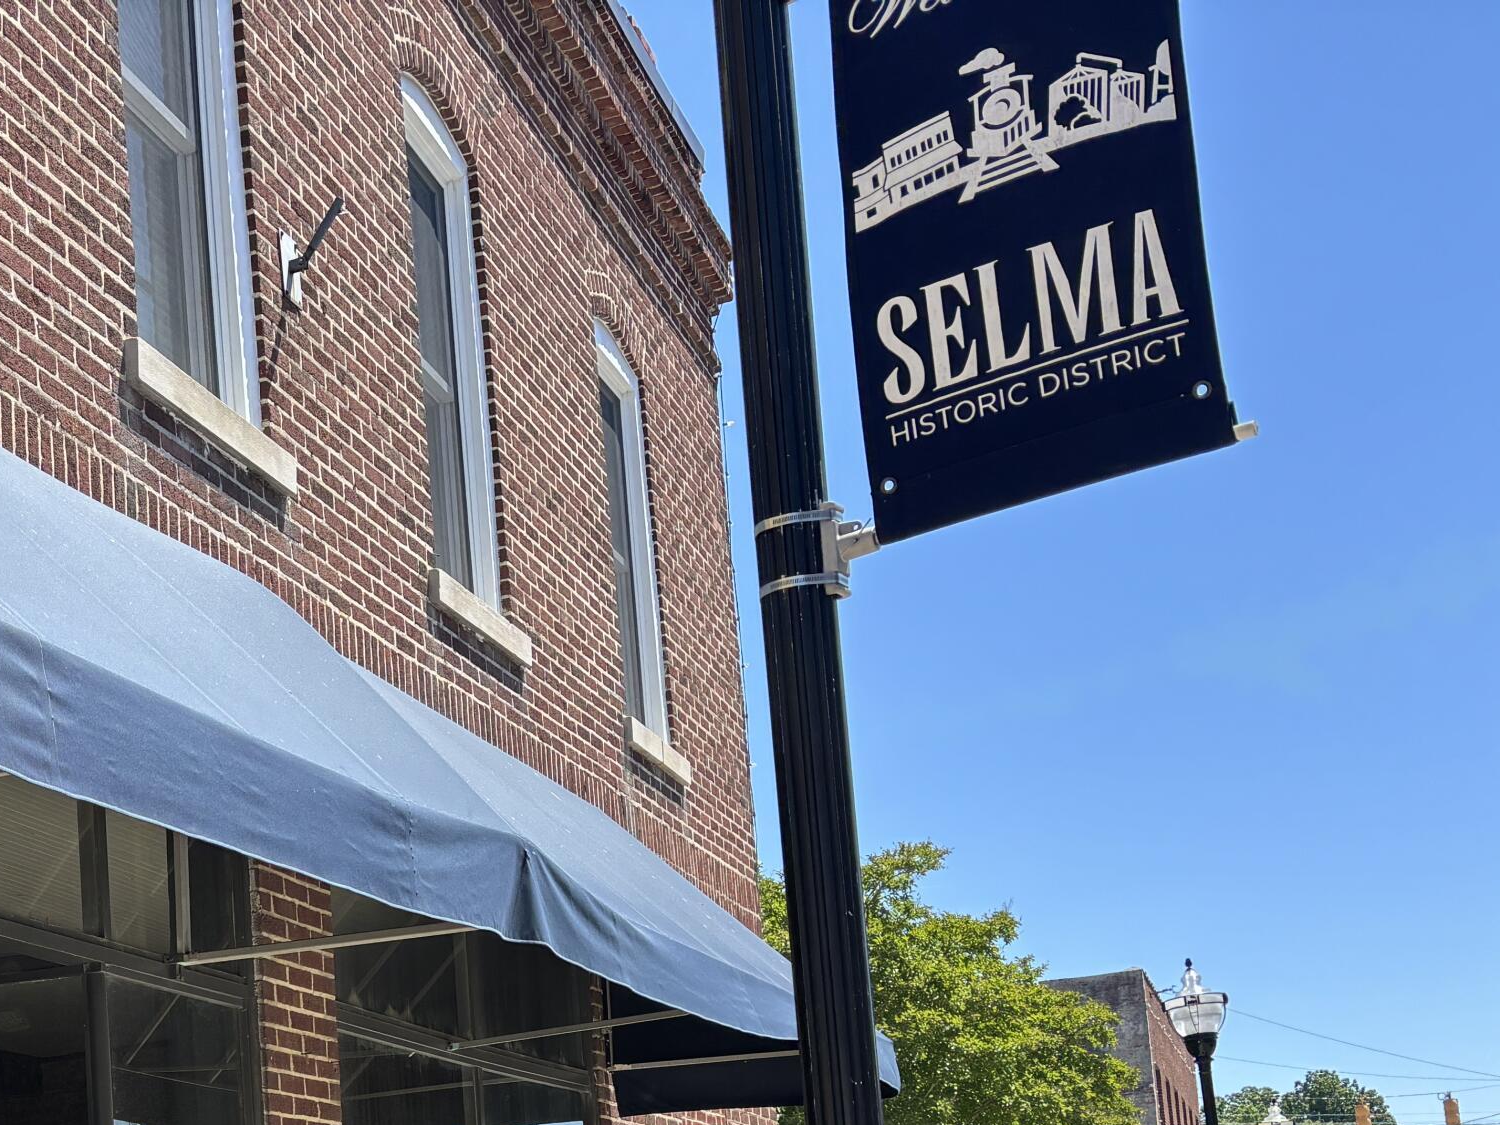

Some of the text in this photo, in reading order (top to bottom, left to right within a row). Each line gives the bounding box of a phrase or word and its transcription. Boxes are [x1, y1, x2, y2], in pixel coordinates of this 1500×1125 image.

[876, 208, 1185, 404] SELMA
[890, 331, 1186, 447] HISTORIC DISTRICT
